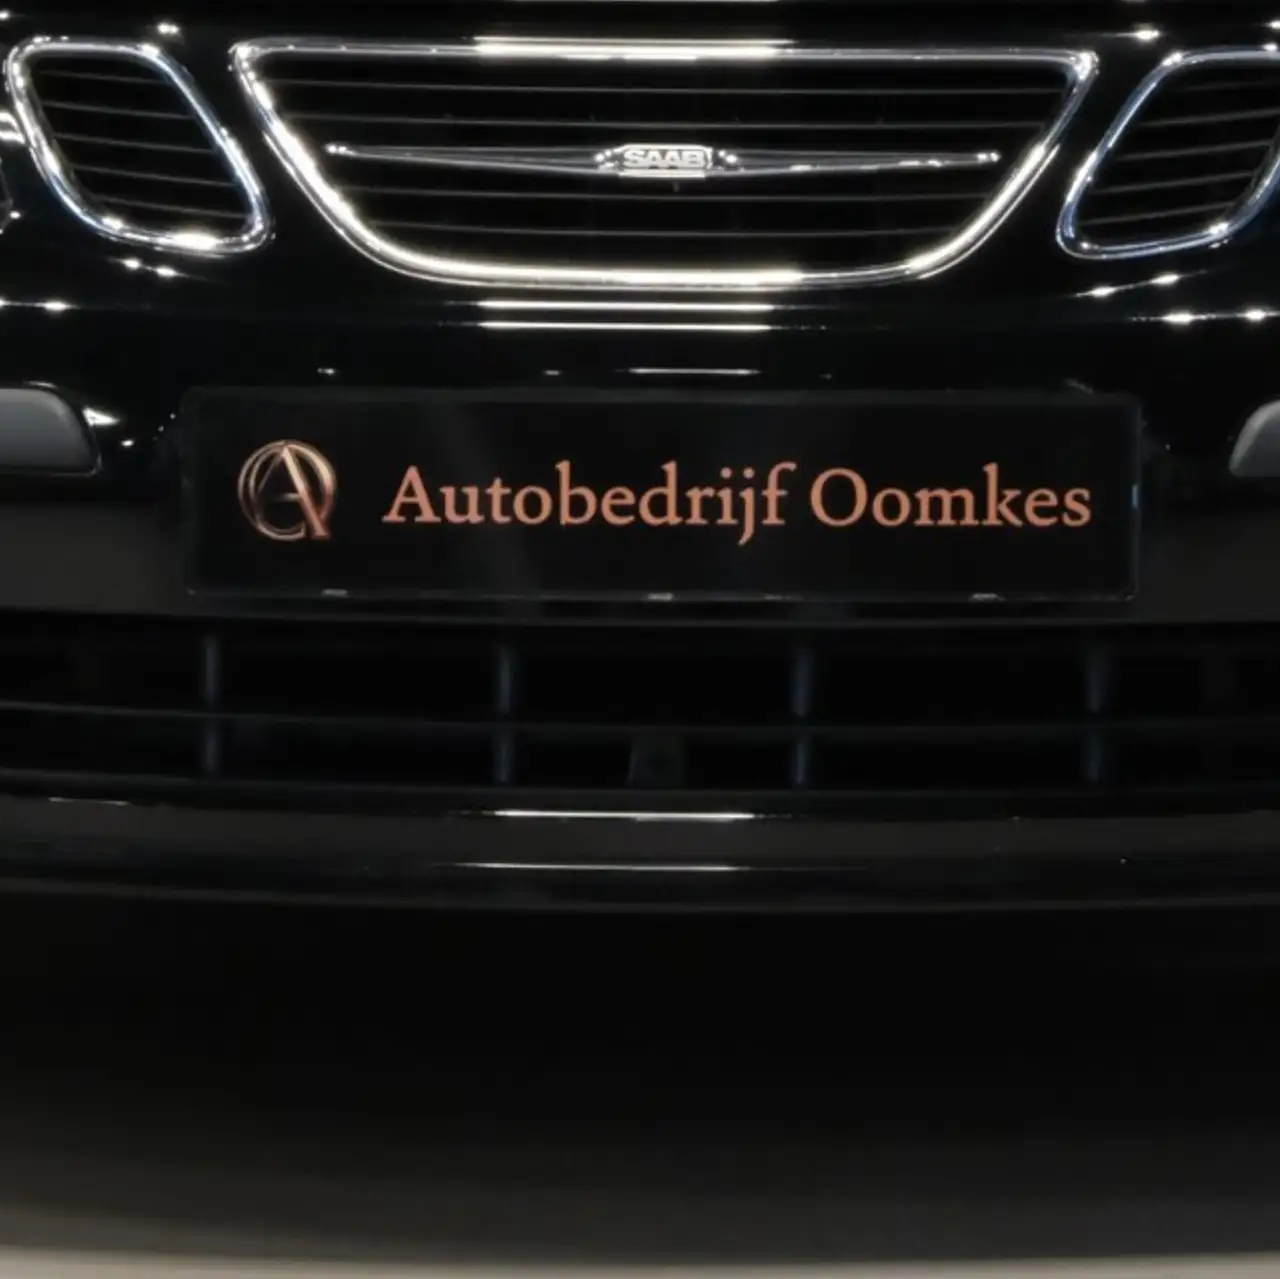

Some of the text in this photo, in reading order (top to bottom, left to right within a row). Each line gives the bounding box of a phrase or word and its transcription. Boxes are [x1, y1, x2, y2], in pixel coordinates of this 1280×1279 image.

[623, 148, 706, 169] SAAB
[384, 460, 1091, 544] Autobedrijf Oomkes
